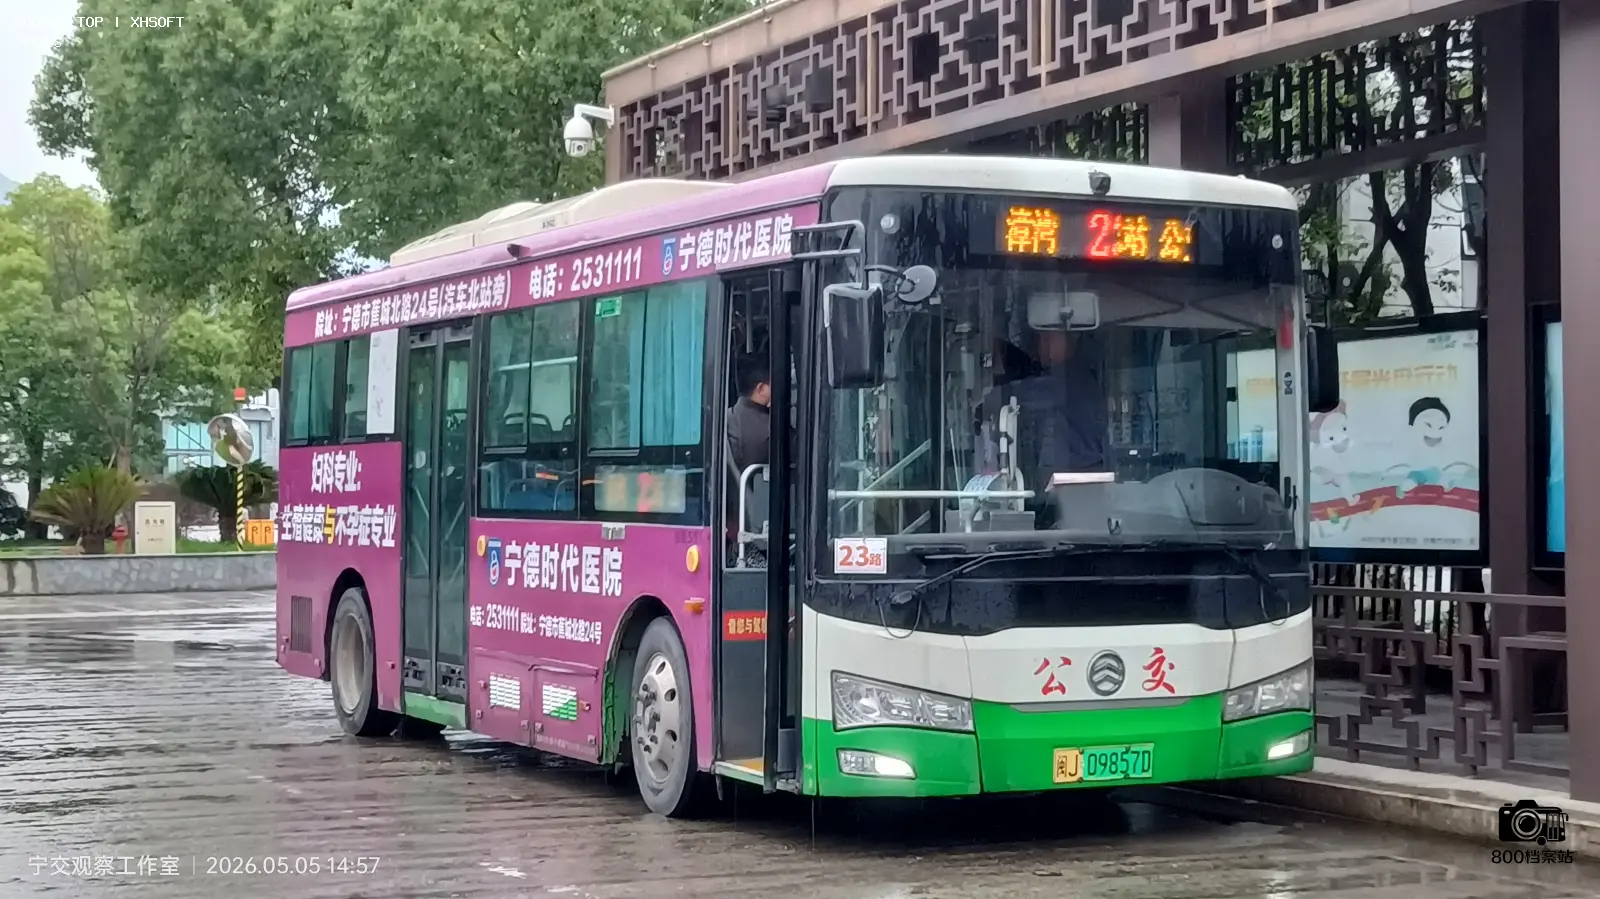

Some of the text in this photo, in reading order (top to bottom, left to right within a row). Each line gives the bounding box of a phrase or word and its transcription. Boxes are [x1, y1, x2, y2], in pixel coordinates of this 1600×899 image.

[678, 213, 793, 271] 宁德时代医院
[504, 540, 623, 596] 宁德时代医院
[839, 545, 882, 567] 23路
[1034, 647, 1175, 695] 公 交
